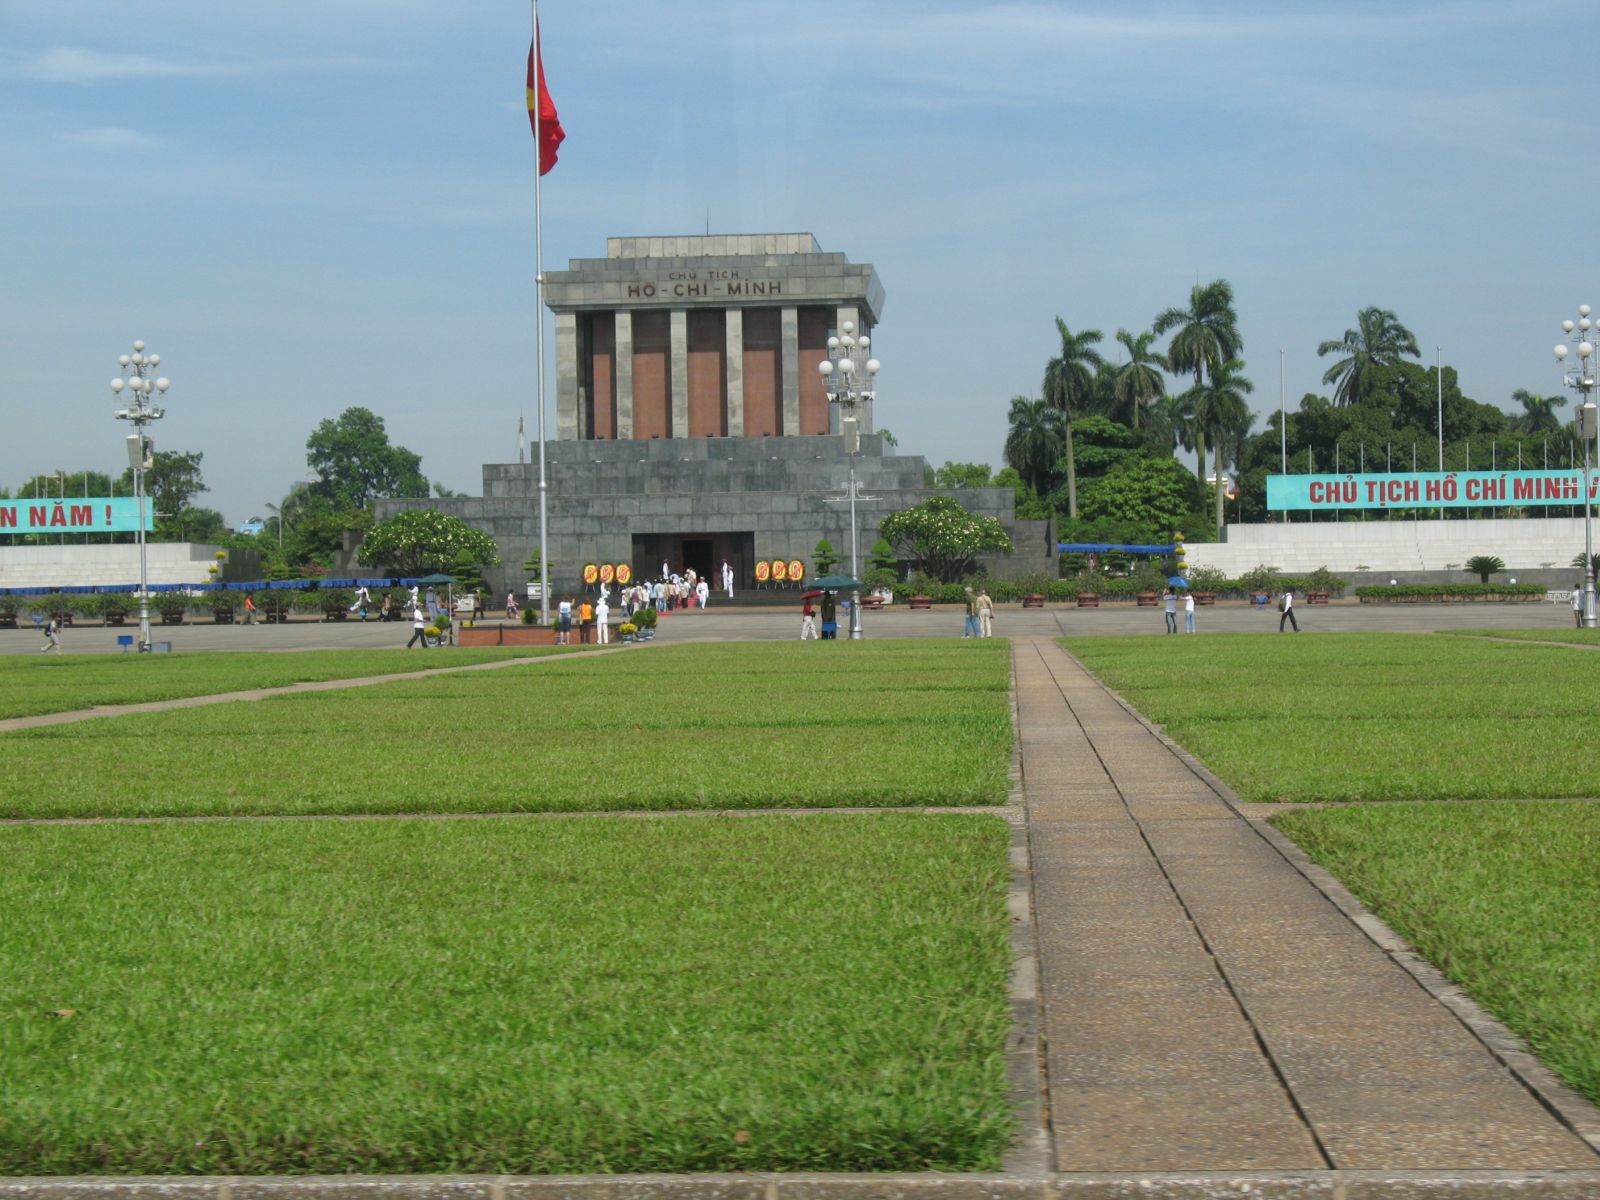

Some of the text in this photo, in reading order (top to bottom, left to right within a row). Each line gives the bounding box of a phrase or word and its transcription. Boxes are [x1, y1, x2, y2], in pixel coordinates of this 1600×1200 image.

[1309, 474, 1358, 503] CHỦ
[1365, 480, 1419, 506] TỊCH
[1426, 473, 1457, 501] HỒ
[1466, 474, 1506, 501] CHÍ
[1514, 477, 1578, 499] MINH
[29, 501, 93, 527] NĂM
